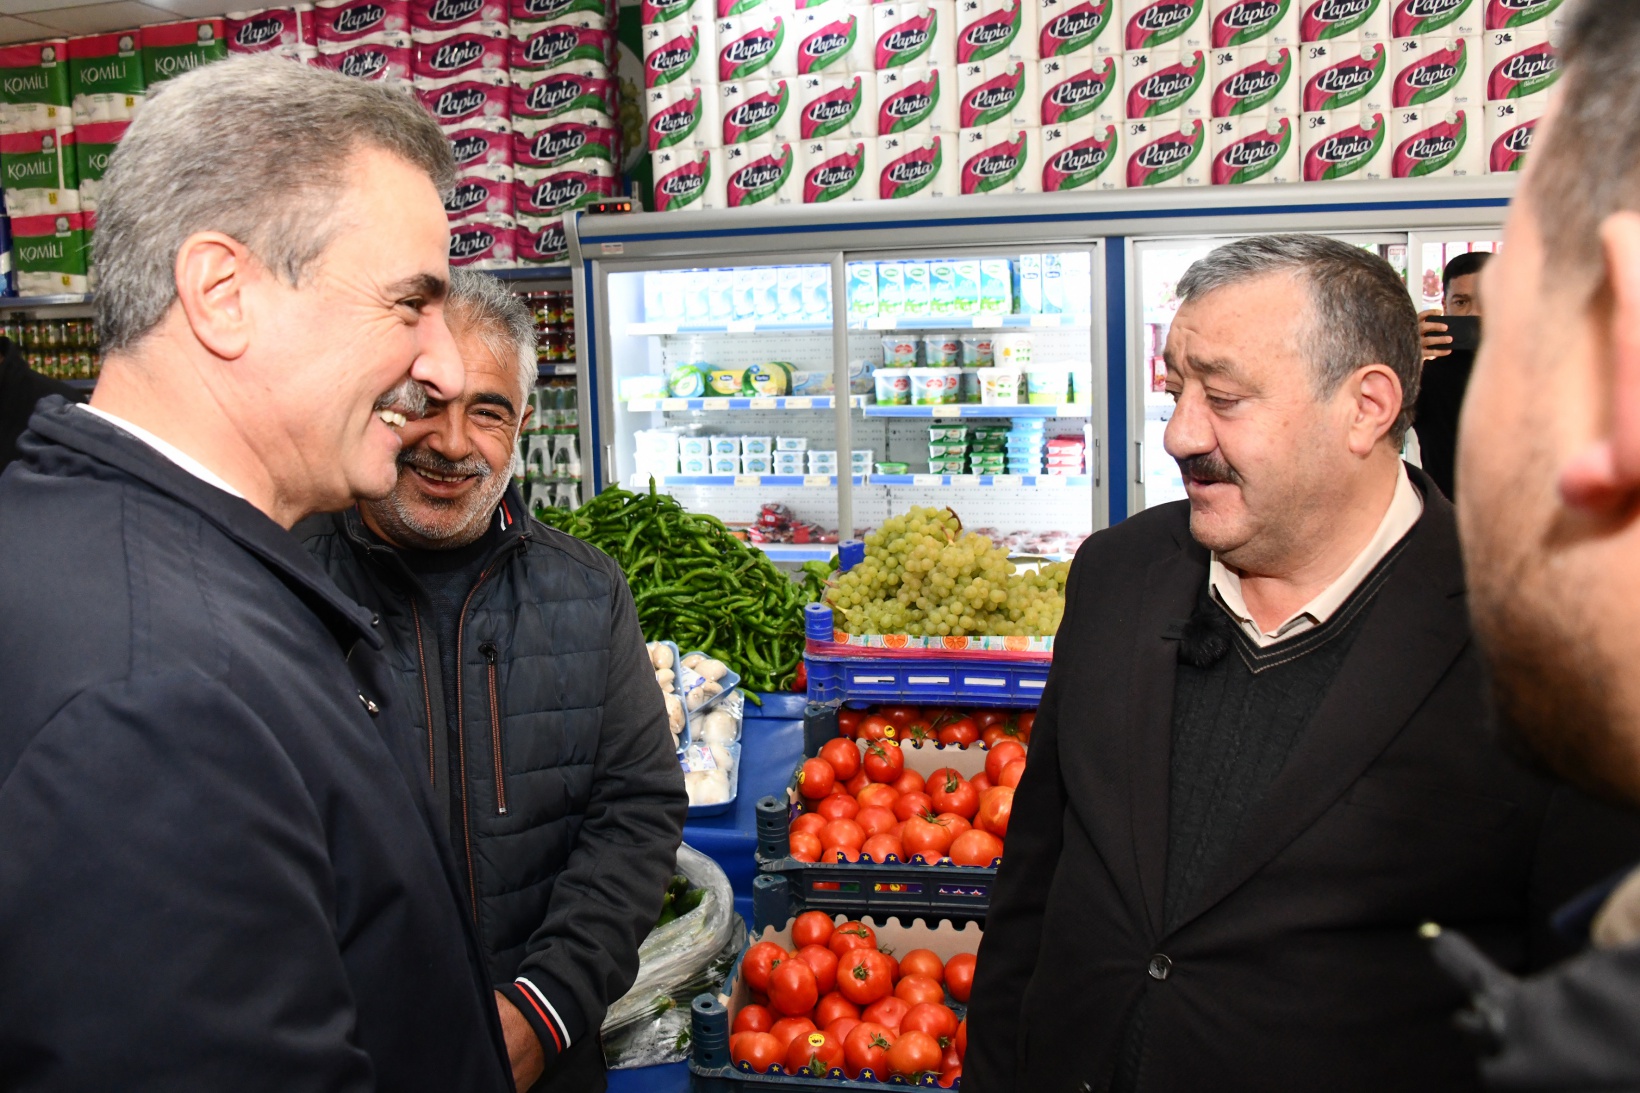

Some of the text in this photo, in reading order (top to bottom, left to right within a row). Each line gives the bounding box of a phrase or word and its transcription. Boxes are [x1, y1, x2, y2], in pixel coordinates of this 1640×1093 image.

[338, 4, 383, 32] Papia
[1143, 4, 1191, 29] Papia
[1228, 1, 1277, 27] Papia
[1318, 0, 1368, 21] Papia
[240, 19, 281, 44] Papia
[970, 23, 1011, 44] Papia
[1053, 12, 1100, 37] Papia
[529, 32, 577, 62] Papia
[730, 36, 772, 61] Papia
[810, 33, 847, 54] Papia
[888, 29, 928, 50] Papia
[1402, 42, 1409, 52] 3
[1495, 34, 1503, 46] 3
[434, 41, 483, 69] Papia
[654, 49, 691, 69] Papia
[1132, 56, 1140, 67] 3
[1217, 54, 1225, 65] 3
[1309, 48, 1317, 59] 3
[80, 62, 127, 85] KOMİLİ
[967, 66, 974, 76] 3
[1044, 64, 1052, 74] 3
[1411, 63, 1457, 87] Papia
[1508, 53, 1557, 78] Papia
[4, 72, 49, 94] KOMİLİ
[1145, 74, 1192, 99] Papia
[1229, 71, 1278, 97] Papia
[1321, 66, 1371, 91] Papia
[437, 89, 485, 115] Papia
[532, 80, 580, 110] Papia
[974, 87, 1015, 108] Papia
[1056, 80, 1103, 105] Papia
[735, 101, 777, 126] Papia
[813, 99, 852, 120] Papia
[892, 94, 931, 116] Papia
[1497, 105, 1505, 117] 3
[658, 112, 693, 131] Papia
[1217, 124, 1225, 134] 3
[1309, 117, 1317, 128] 3
[1403, 113, 1411, 123] 3
[969, 133, 976, 142] 3
[1046, 131, 1053, 140] 3
[1131, 125, 1138, 135] 3
[536, 130, 584, 160] Papia
[1142, 141, 1191, 166] Papia
[1228, 140, 1278, 166] Papia
[1321, 135, 1370, 160] Papia
[1411, 136, 1456, 158] Papia
[8, 158, 52, 180] KOMİLİ
[893, 160, 932, 181] Papia
[976, 155, 1016, 176] Papia
[1058, 147, 1105, 172] Papia
[666, 173, 703, 193] Papia
[739, 163, 782, 188] Papia
[816, 165, 855, 186] Papia
[536, 179, 585, 209] Papia
[539, 229, 568, 252] Pap
[20, 241, 64, 263] KOMİLİ
